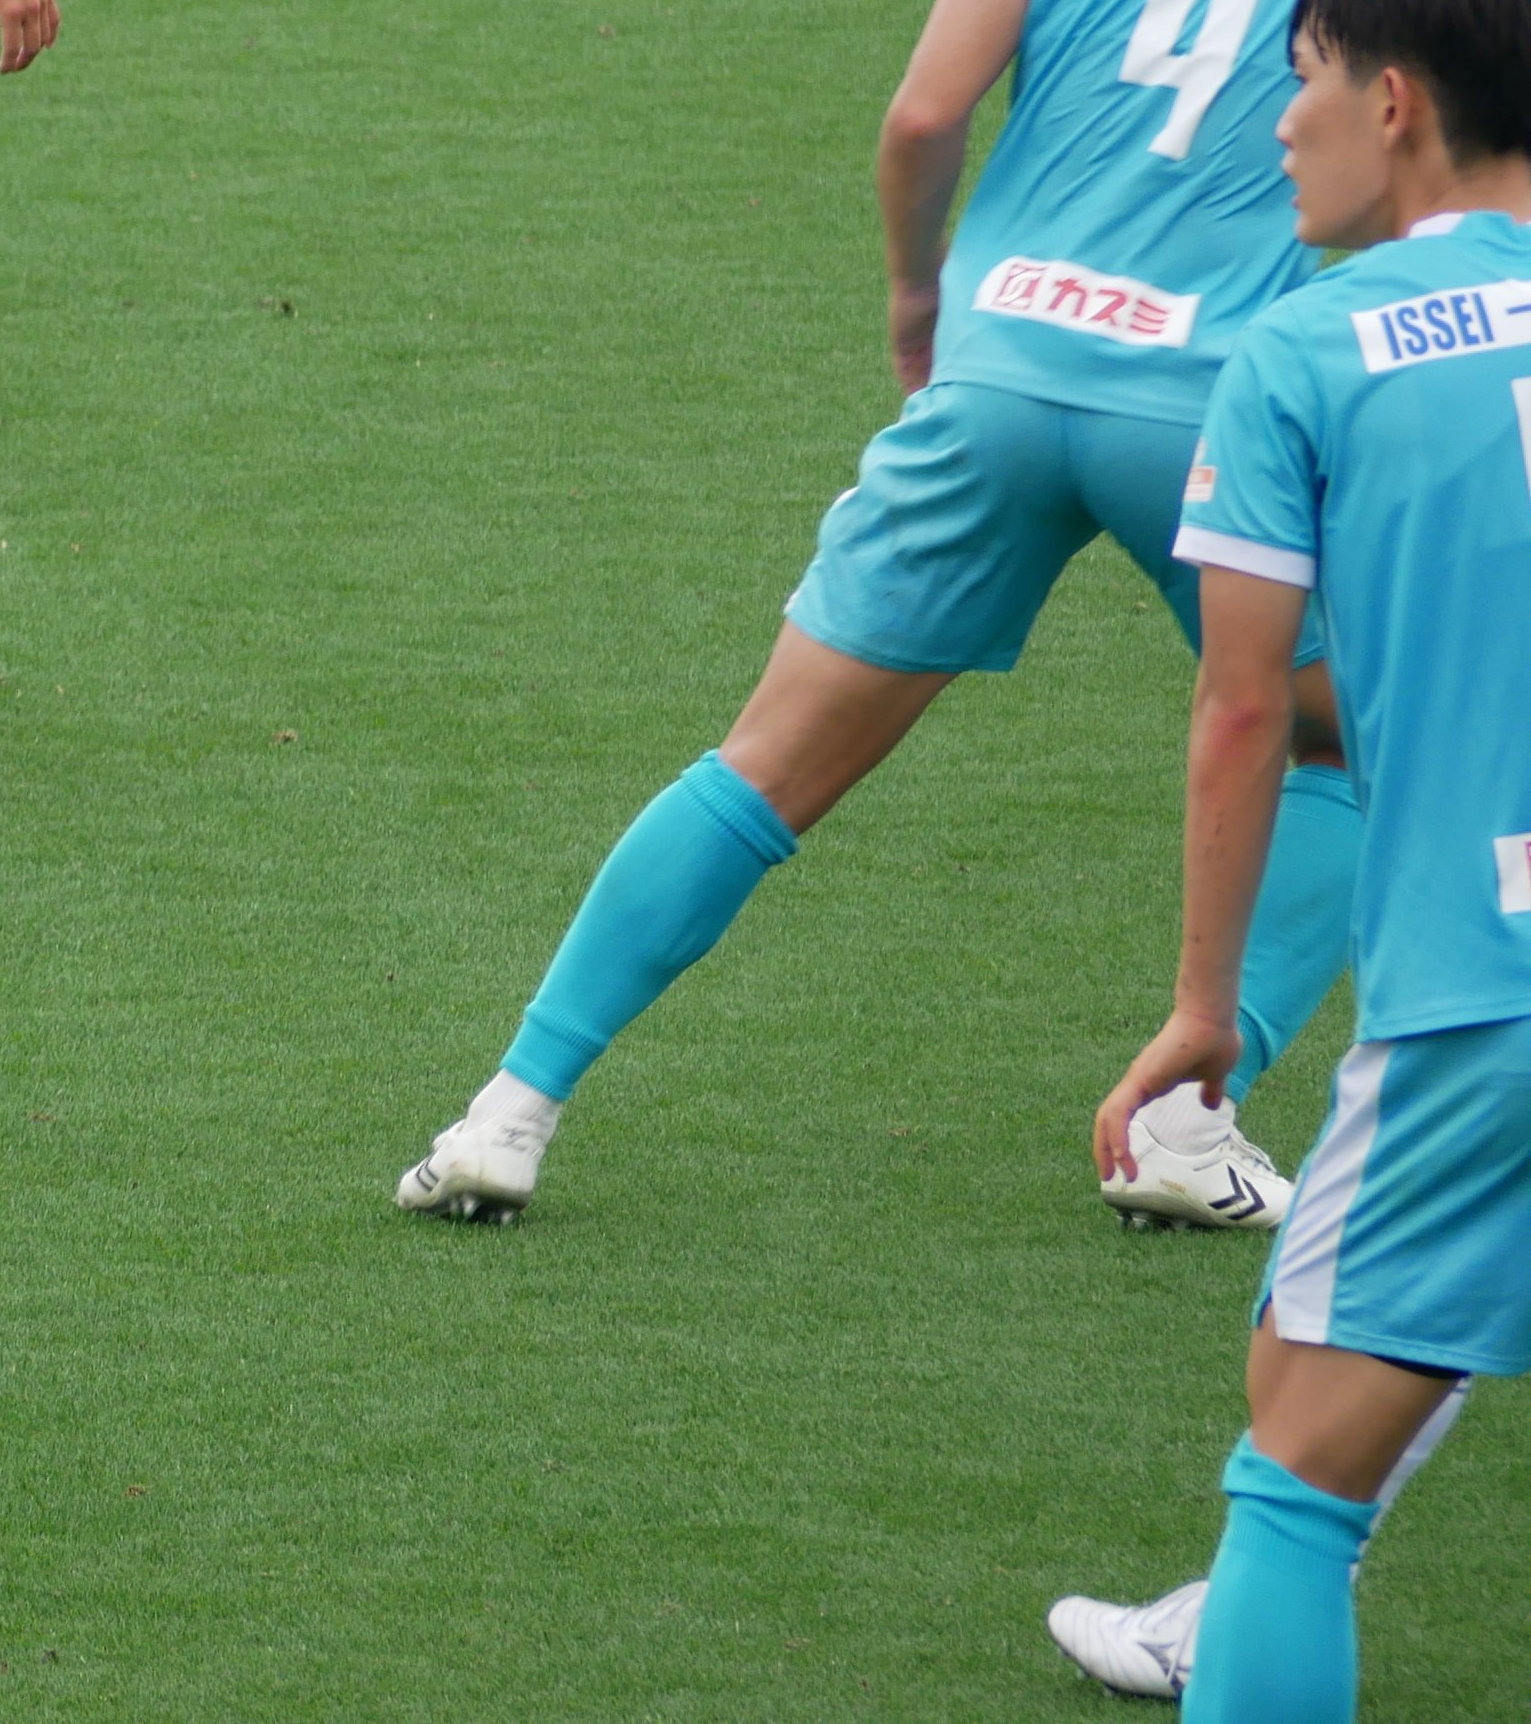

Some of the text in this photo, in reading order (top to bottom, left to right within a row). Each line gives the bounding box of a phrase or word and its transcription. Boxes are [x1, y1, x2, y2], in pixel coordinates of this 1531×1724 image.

[1046, 277, 1169, 335] カスミ
[1379, 292, 1495, 361] ISSEI
